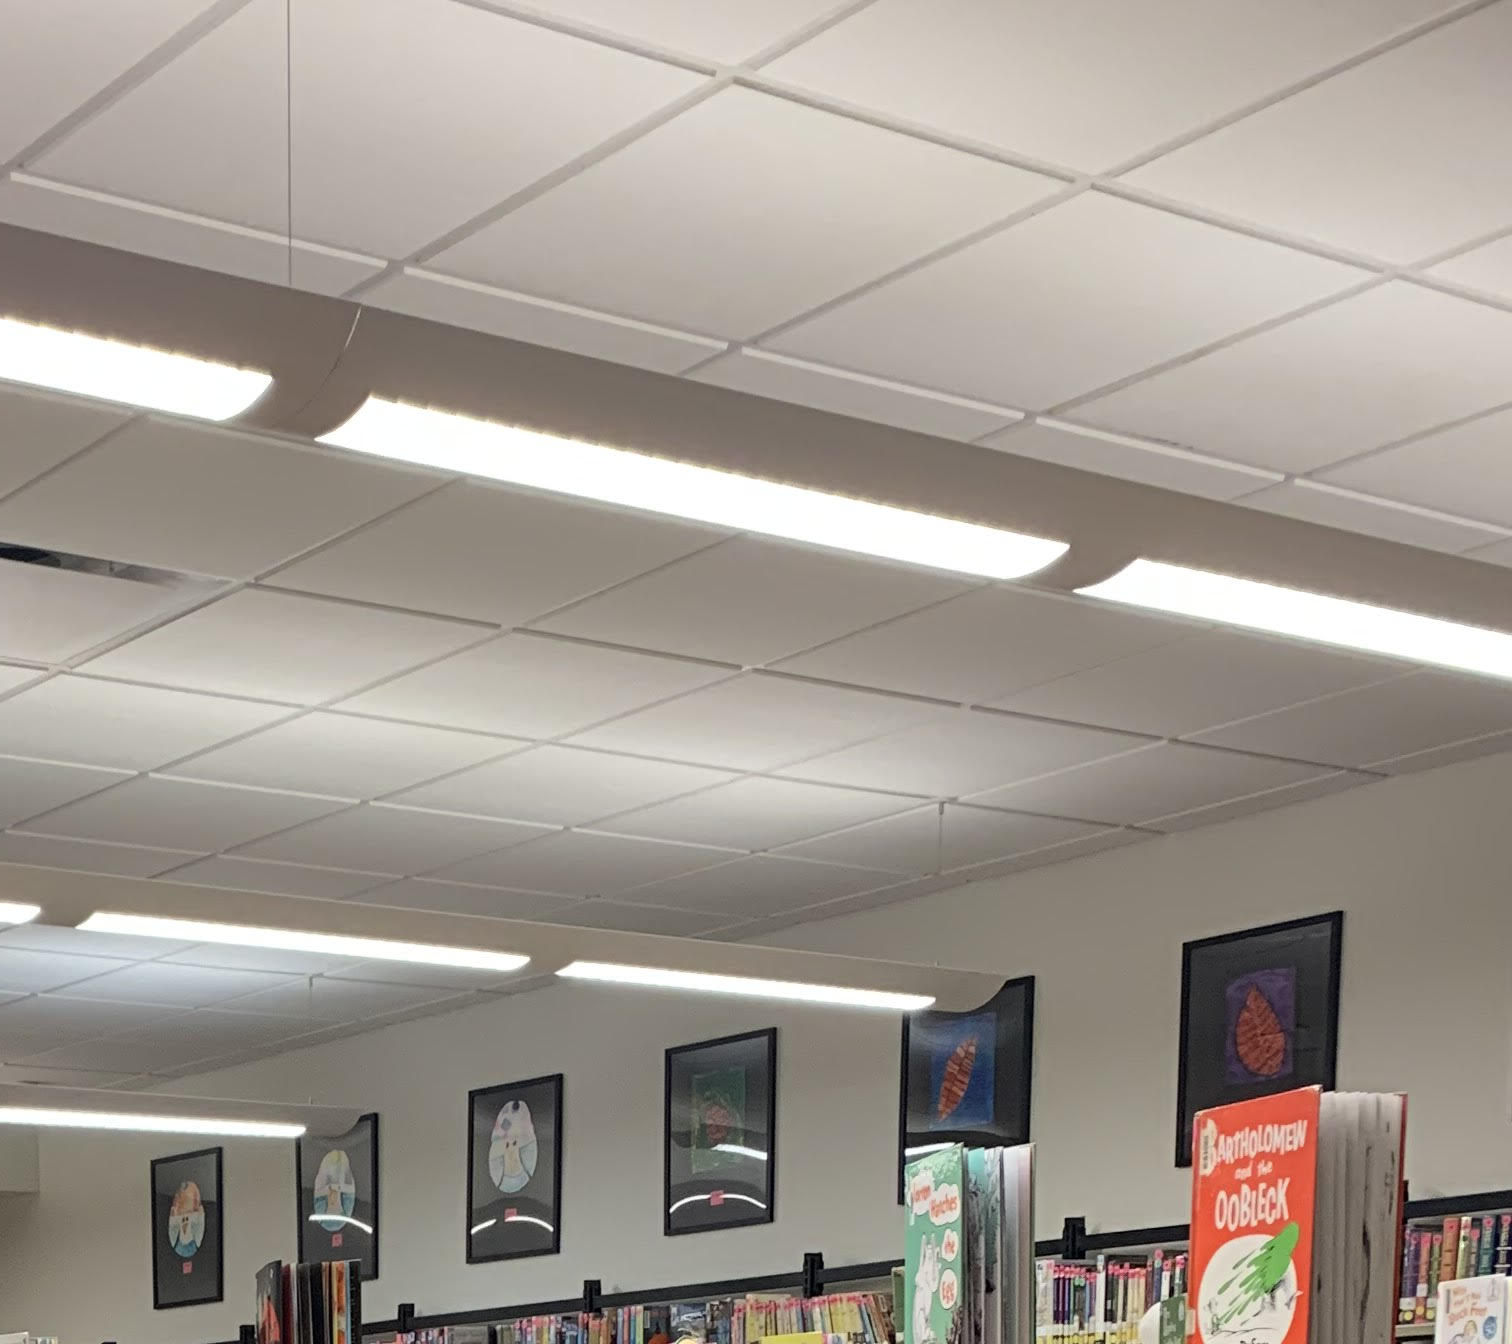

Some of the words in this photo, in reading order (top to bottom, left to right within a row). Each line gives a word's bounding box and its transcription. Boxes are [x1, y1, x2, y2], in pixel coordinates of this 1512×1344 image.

[1199, 1118, 1308, 1176] BARTHOLOMEW
[1234, 1160, 1253, 1180] and
[1257, 1160, 1273, 1177] the
[1215, 1176, 1291, 1233] OOBLECK
